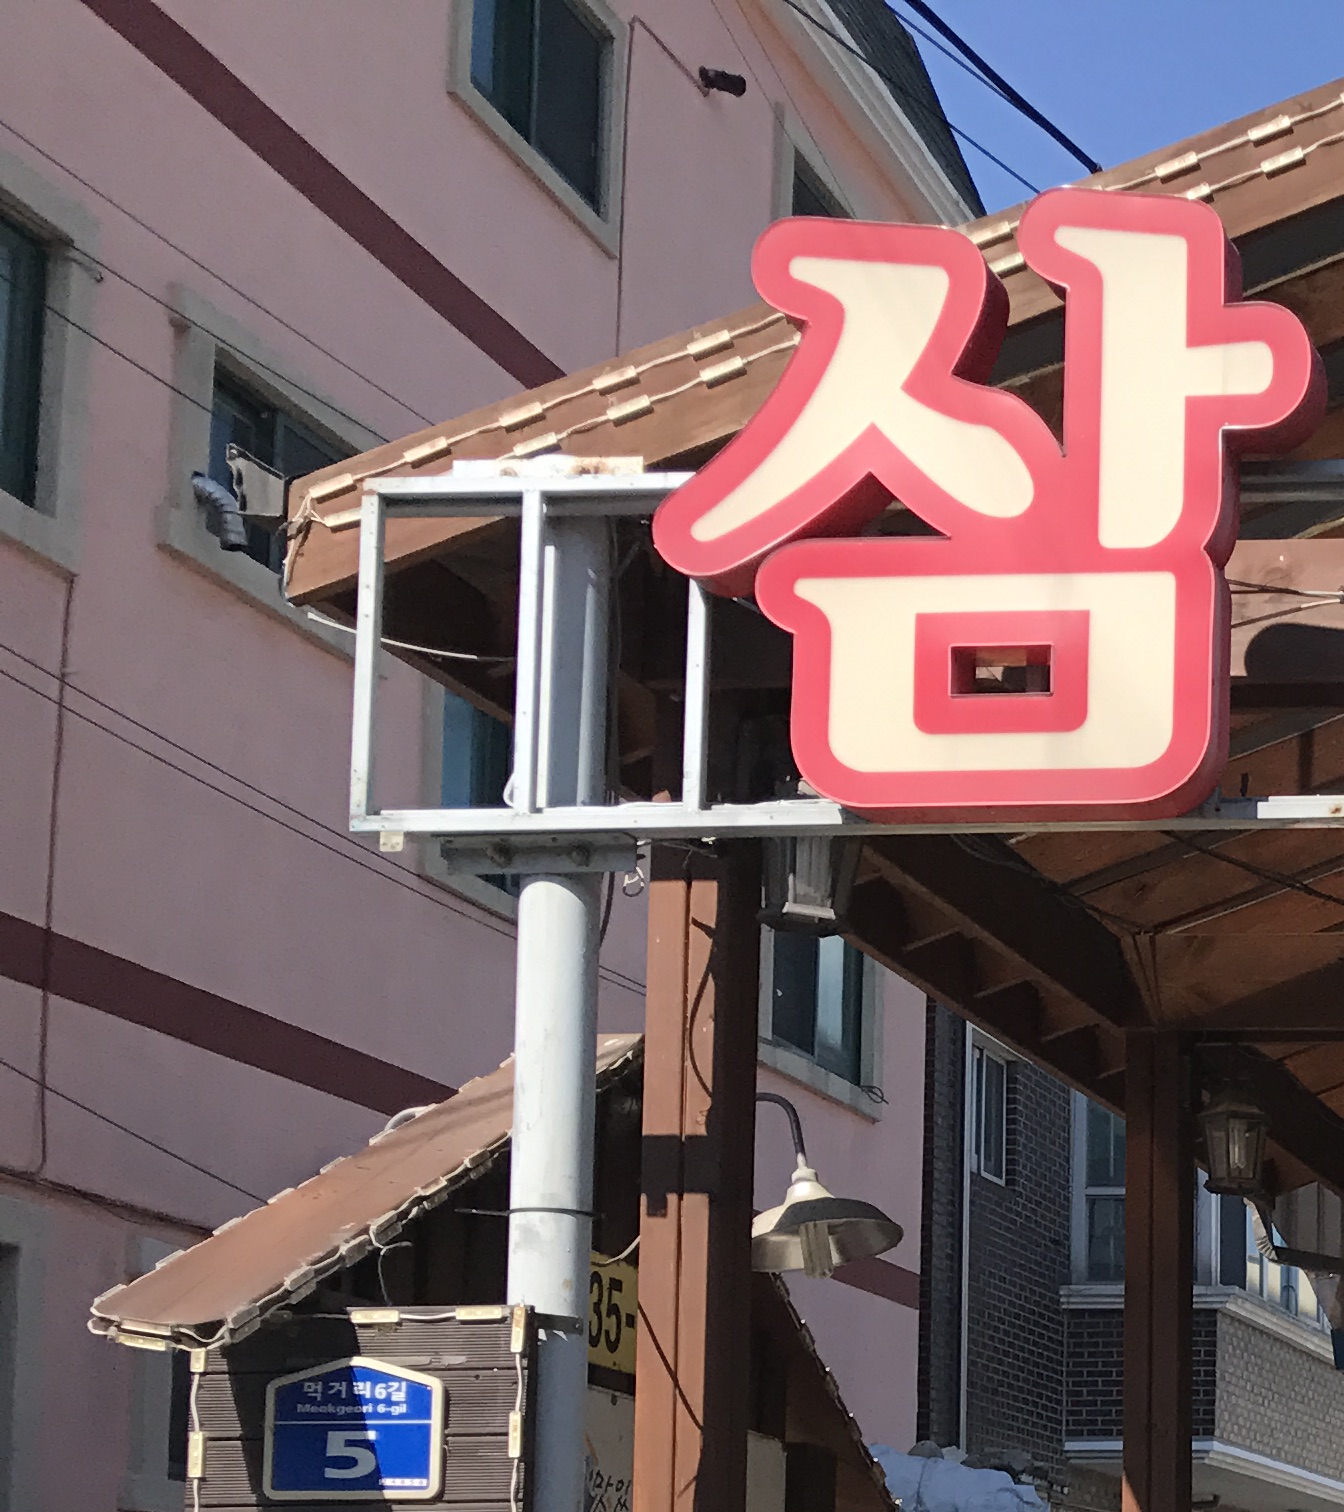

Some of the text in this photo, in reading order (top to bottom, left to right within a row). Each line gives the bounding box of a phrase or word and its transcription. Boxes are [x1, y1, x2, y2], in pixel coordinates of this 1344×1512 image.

[296, 1403, 407, 1416] Meokgeori 6-gil
[323, 1430, 377, 1479] 5
